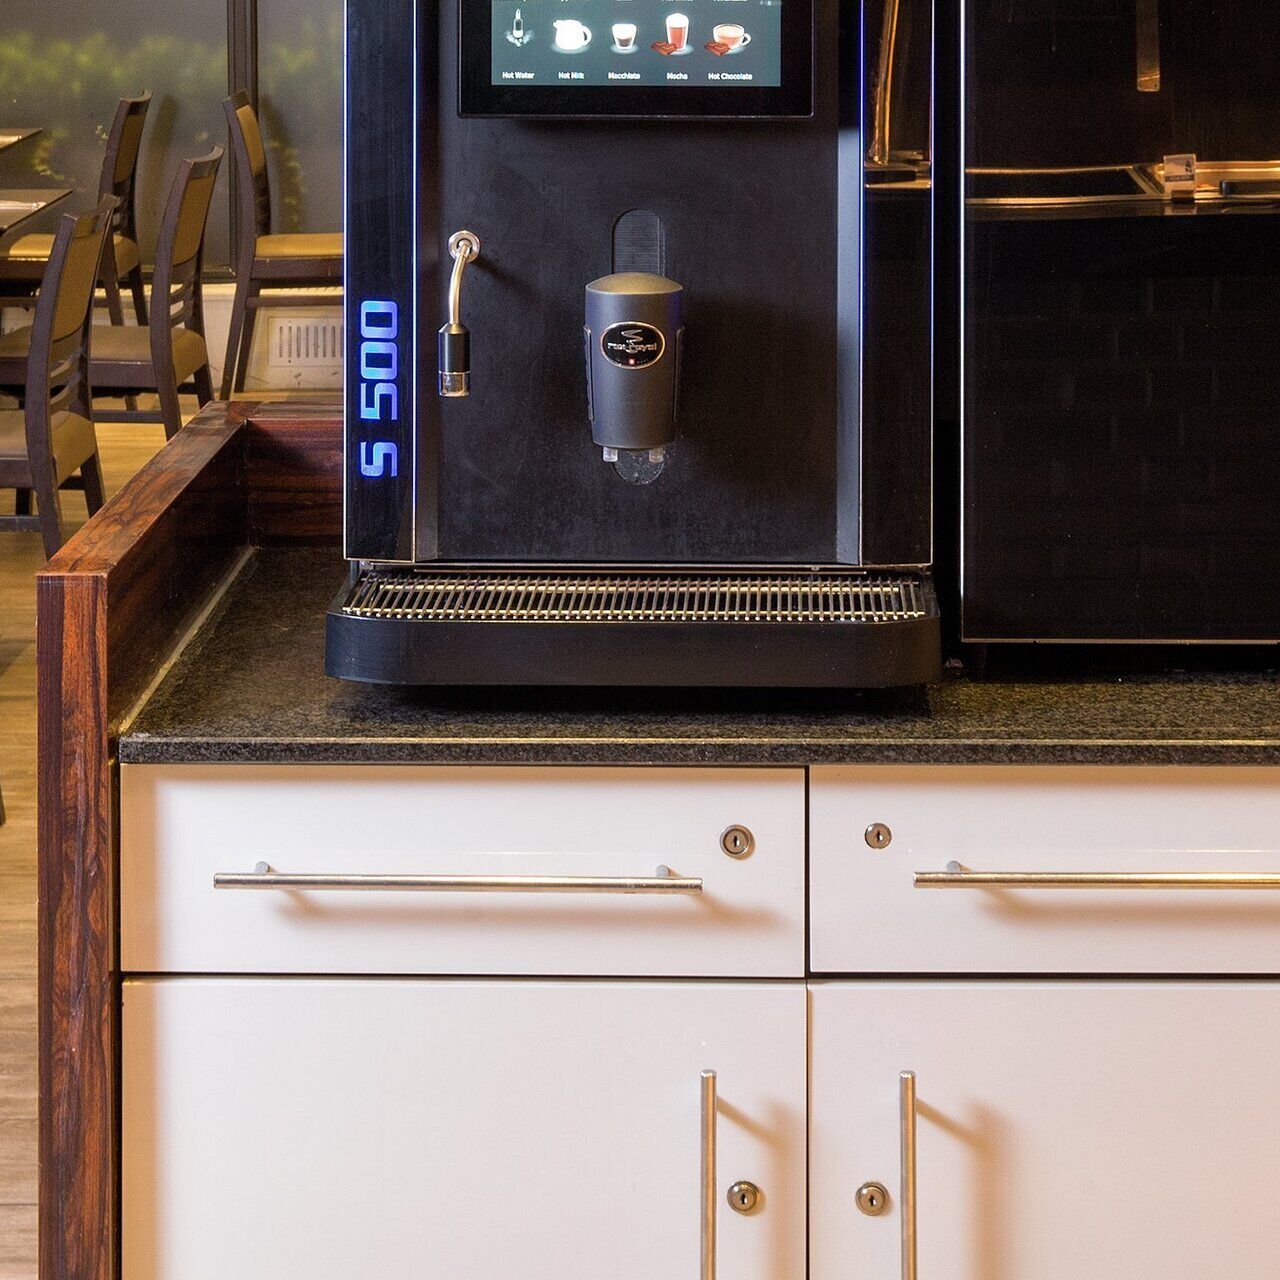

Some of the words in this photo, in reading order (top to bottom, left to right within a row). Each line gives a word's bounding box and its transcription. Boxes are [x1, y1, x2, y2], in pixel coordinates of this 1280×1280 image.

[502, 71, 514, 79] Hot
[515, 71, 535, 79] Water
[558, 71, 570, 79] Hot
[608, 71, 641, 80] Macchiato
[666, 72, 688, 80] Mocha
[708, 72, 720, 80] Hot
[721, 72, 753, 80] Chocolate
[360, 300, 398, 421] 500
[360, 441, 398, 477] S
